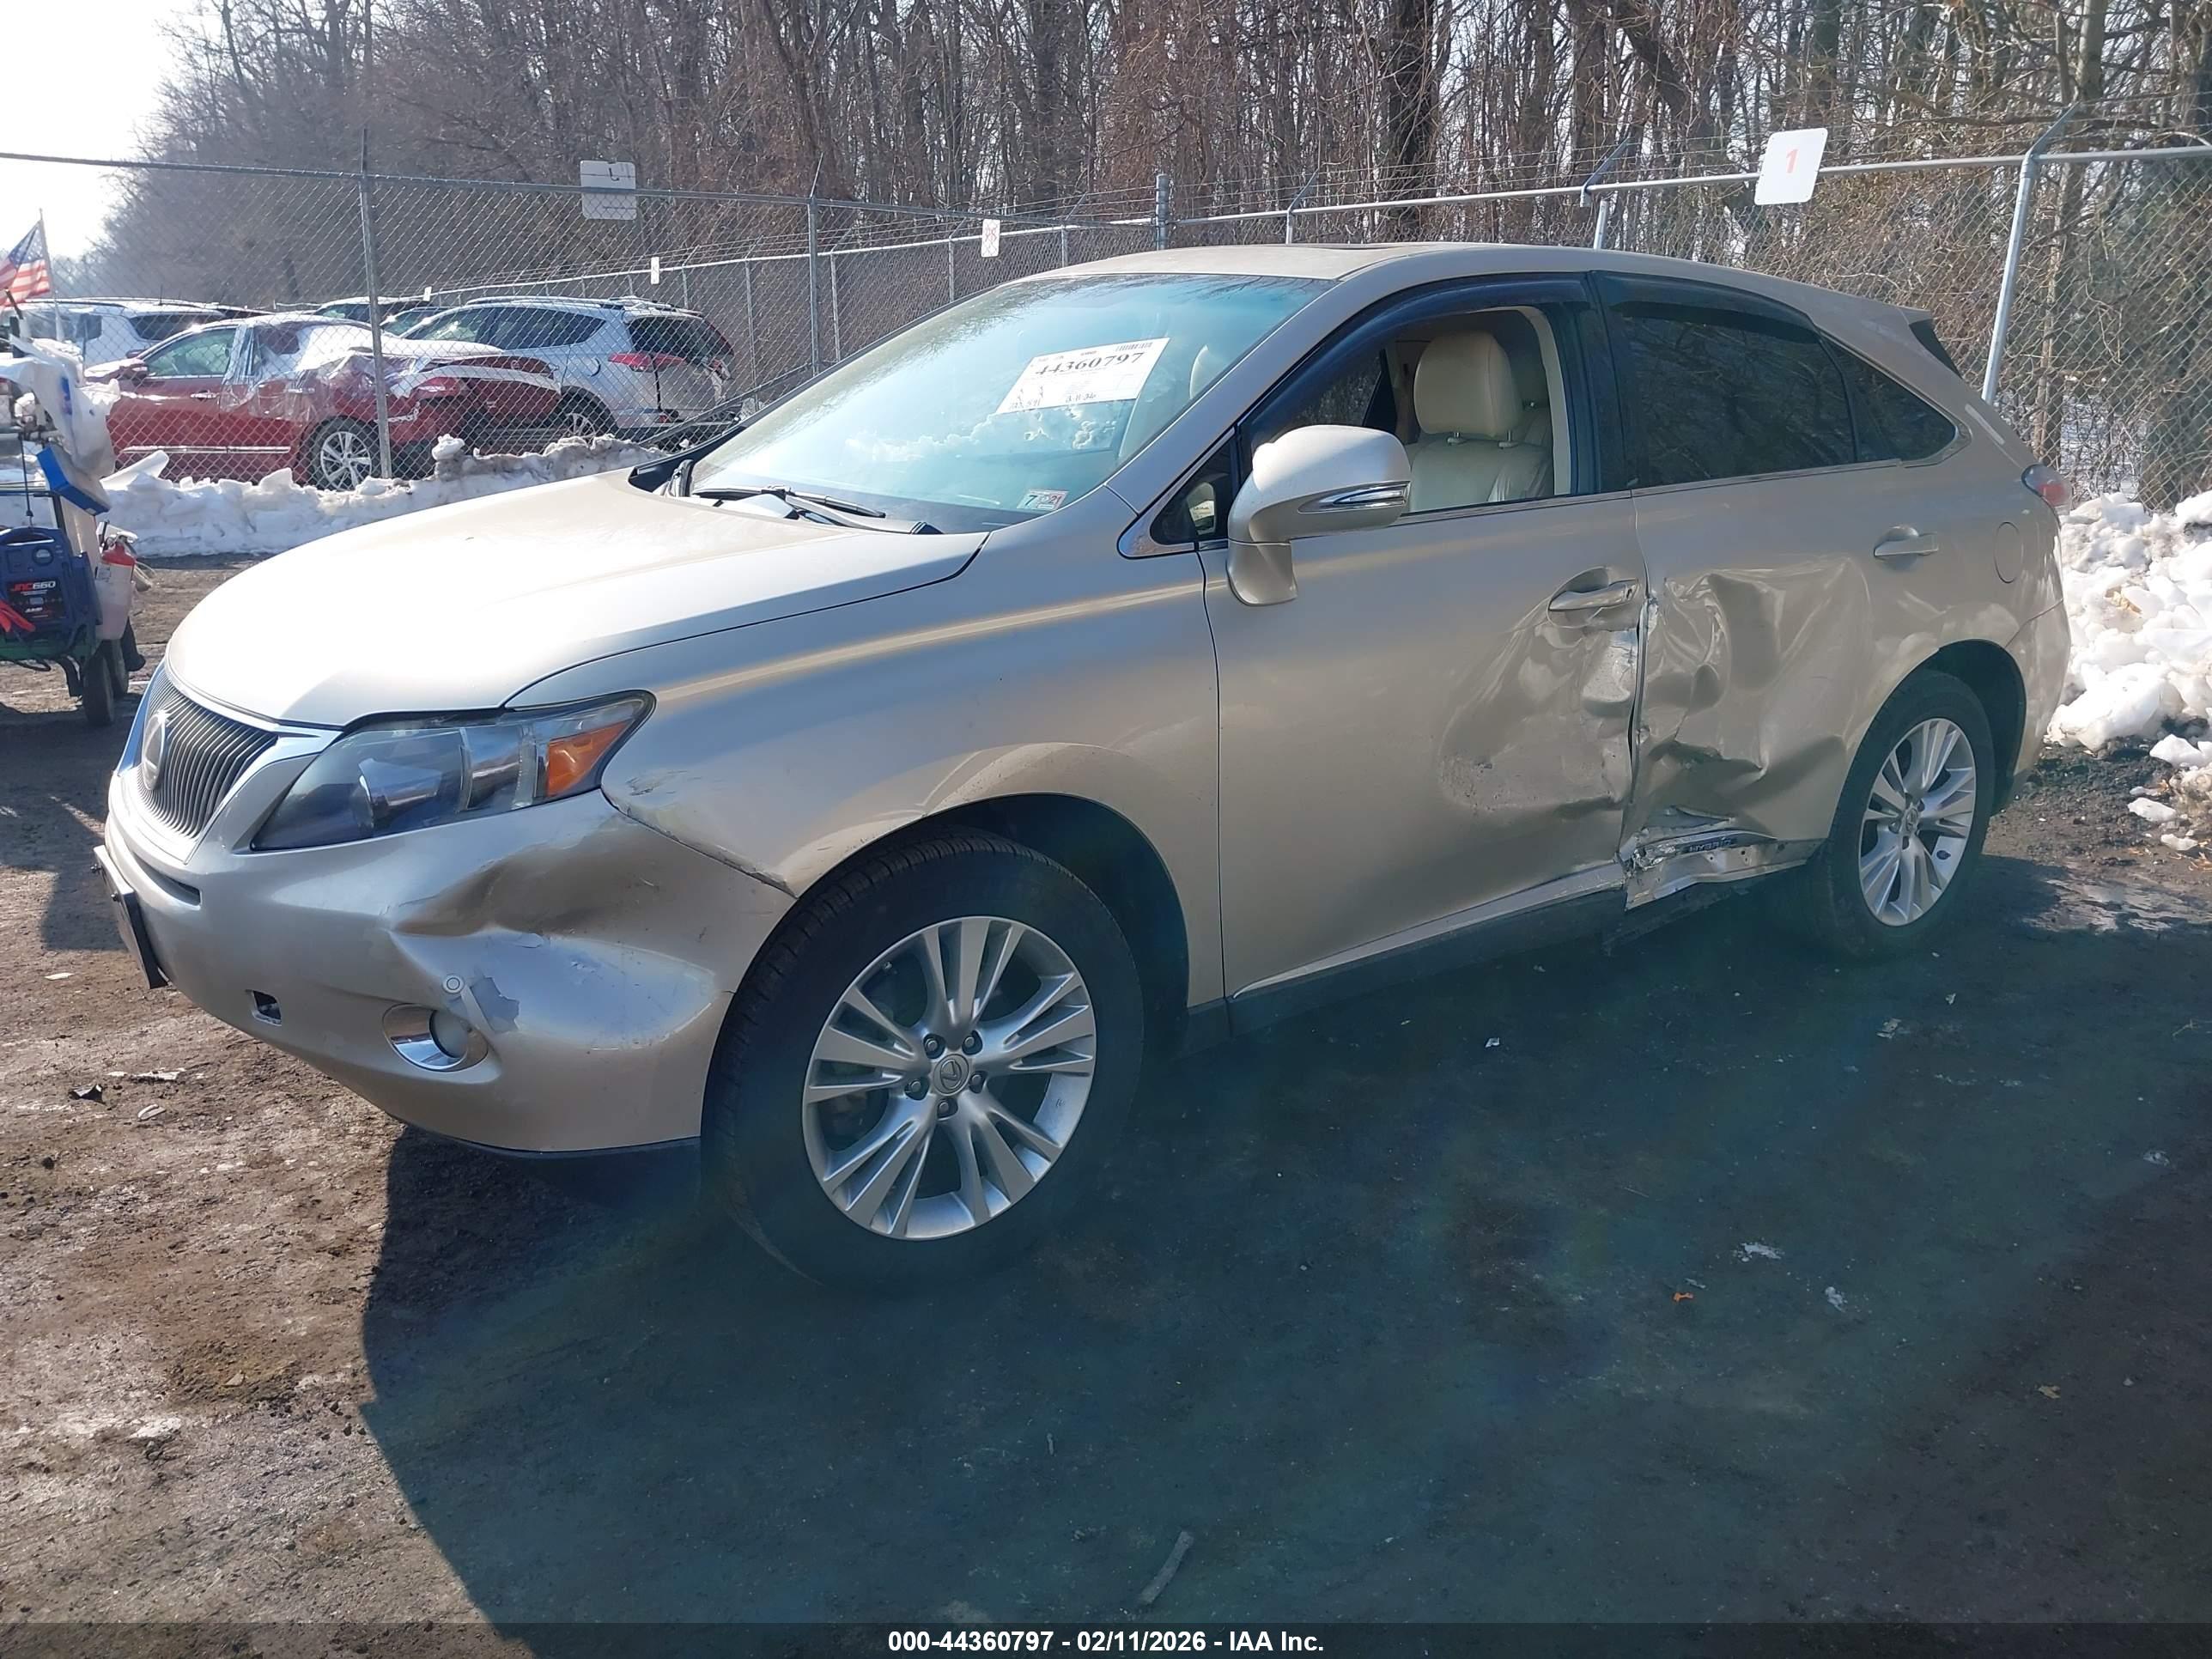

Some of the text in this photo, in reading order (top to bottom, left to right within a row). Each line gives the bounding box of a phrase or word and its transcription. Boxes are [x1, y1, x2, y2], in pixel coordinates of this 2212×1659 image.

[1785, 149, 1799, 173] 1
[1036, 352, 1146, 375] 44360797
[1024, 495, 1062, 506] 7 21
